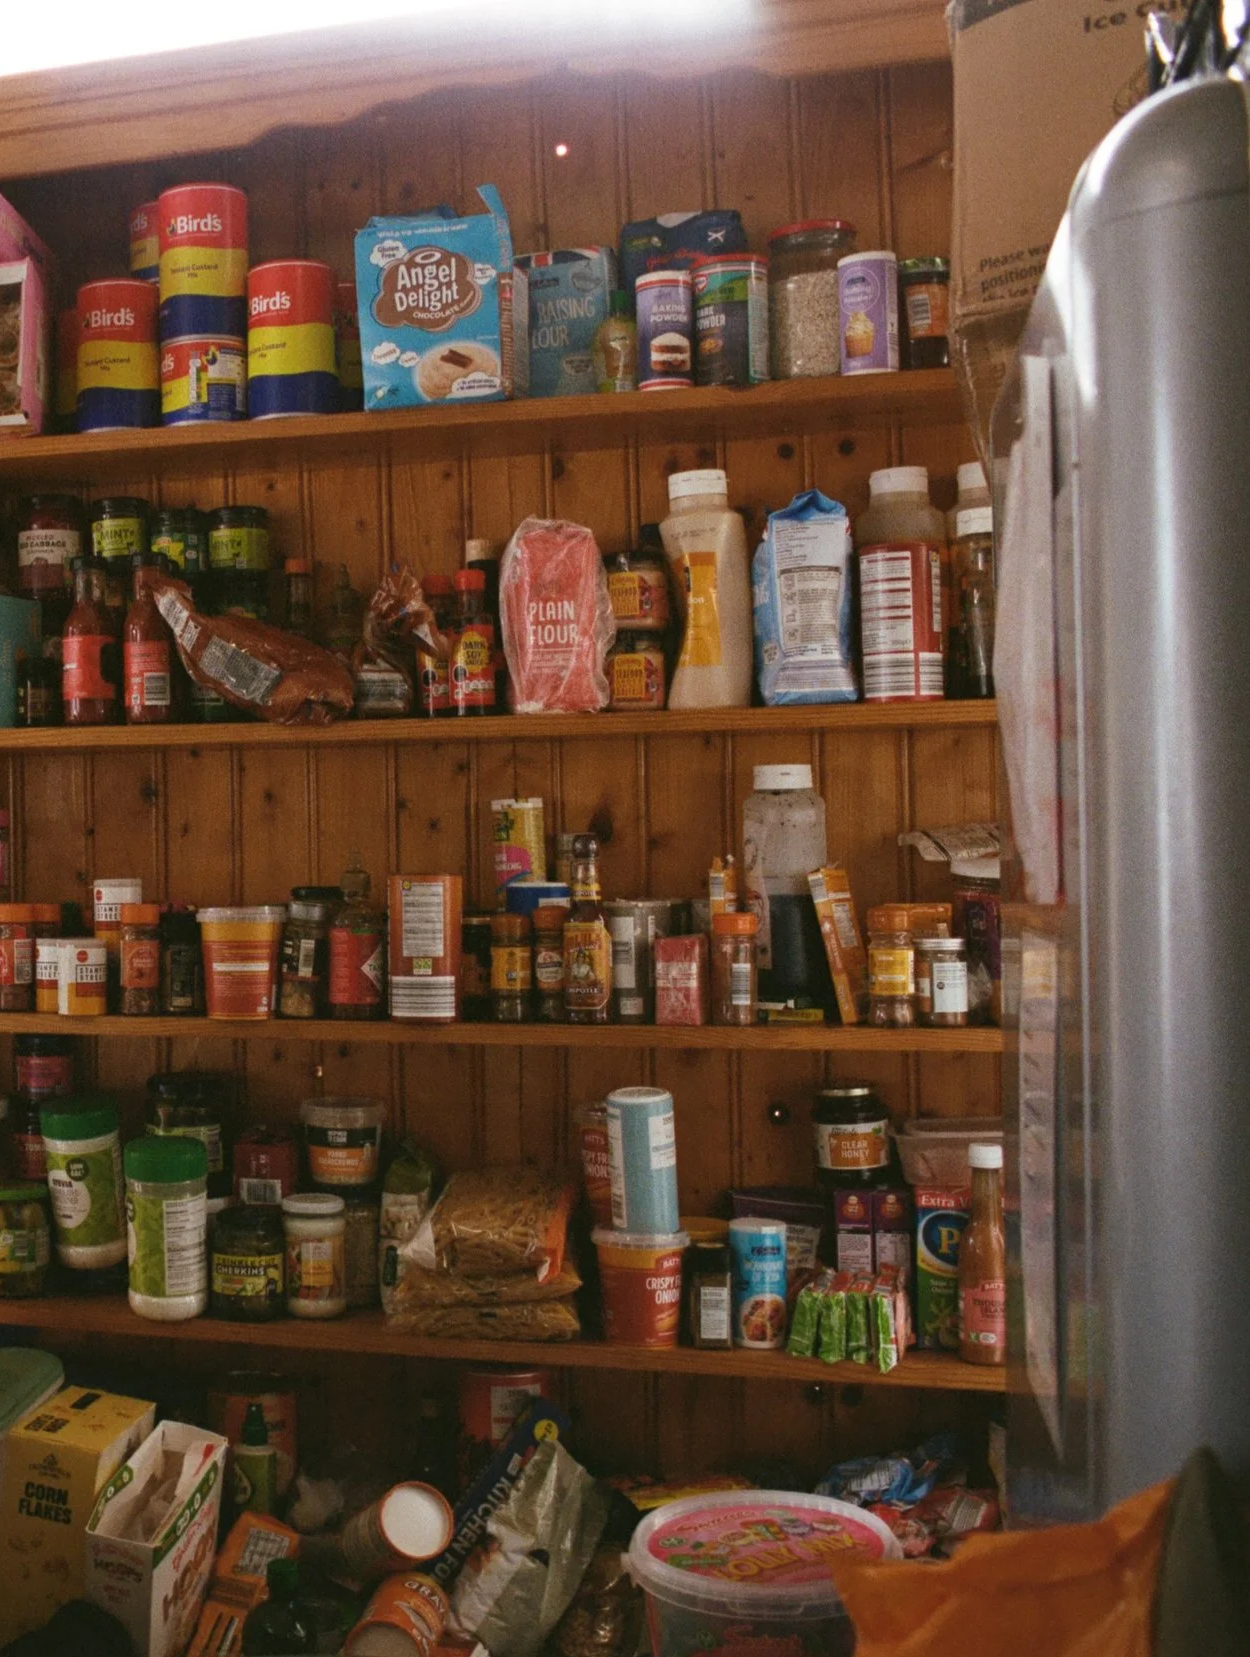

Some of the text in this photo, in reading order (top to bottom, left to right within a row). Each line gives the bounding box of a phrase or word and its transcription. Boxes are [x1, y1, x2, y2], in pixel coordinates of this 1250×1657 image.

[1083, 12, 1127, 33] Ice
[176, 212, 222, 234] Bird's
[979, 251, 1025, 273] Please
[397, 256, 456, 291] Angel
[251, 291, 291, 316] Bird's
[394, 282, 459, 311] Delight
[91, 308, 135, 328] Bird's
[412, 304, 460, 319] CHOCOLATE
[537, 297, 595, 323] RAISING
[652, 303, 686, 314] BAKING
[529, 600, 575, 622] PLAIN
[463, 641, 486, 650] DARK
[529, 624, 580, 646] FLOUR
[466, 651, 482, 659] SOY
[841, 1140, 868, 1149] CLEAR
[841, 1149, 870, 1159] HONEY
[921, 1194, 955, 1208] Extra
[216, 1265, 265, 1275] GHERKINS
[646, 1277, 675, 1290] CRISPY
[24, 1481, 69, 1506] CORN
[18, 1496, 72, 1525] FLAKES
[452, 1476, 512, 1556] KITCHEN
